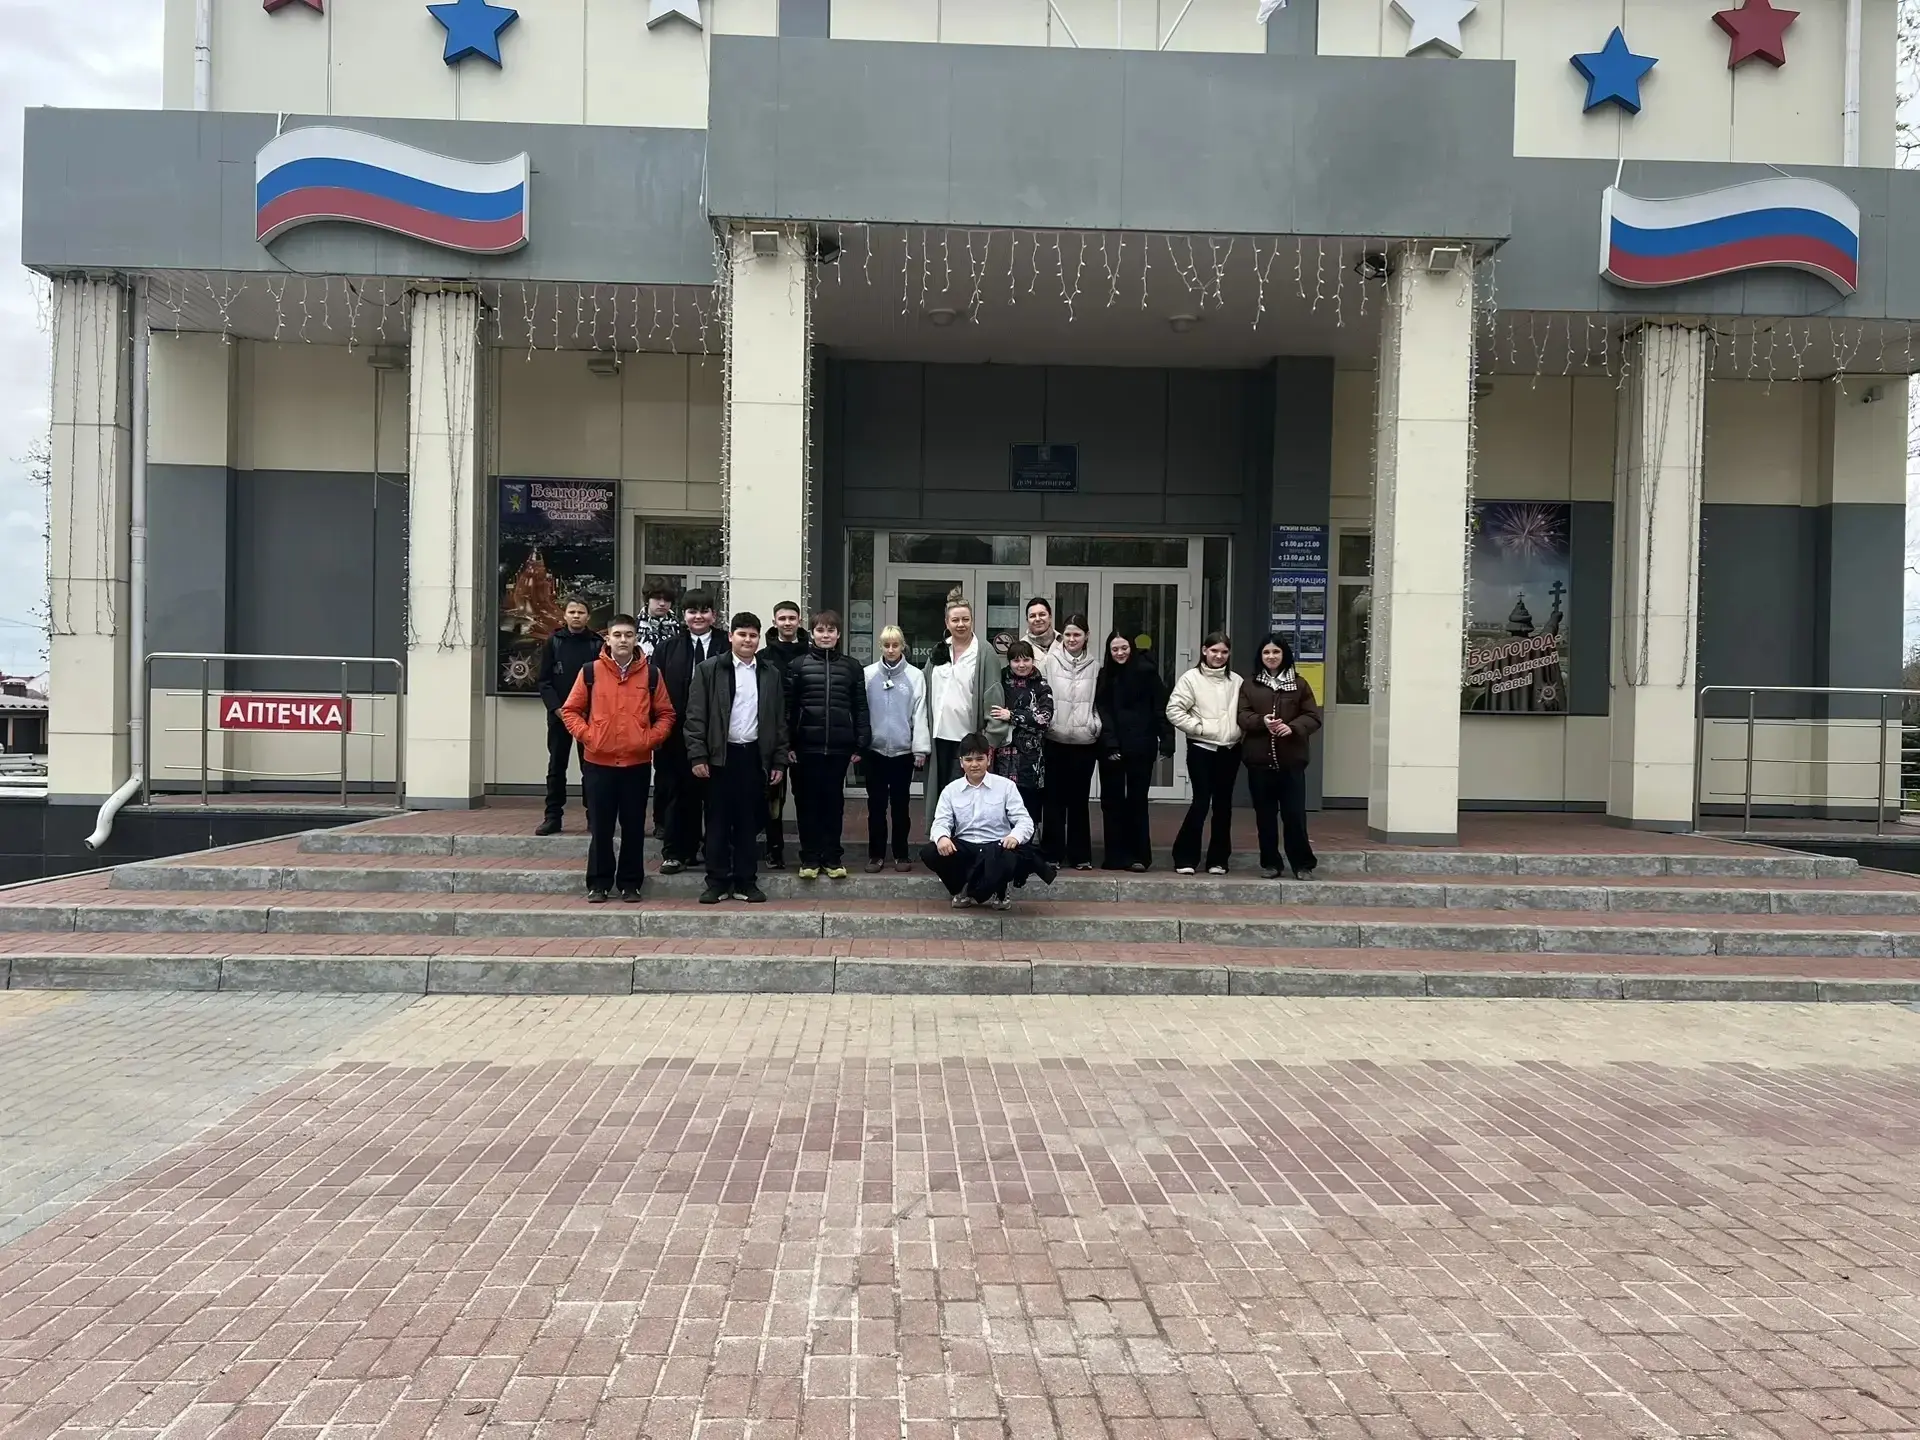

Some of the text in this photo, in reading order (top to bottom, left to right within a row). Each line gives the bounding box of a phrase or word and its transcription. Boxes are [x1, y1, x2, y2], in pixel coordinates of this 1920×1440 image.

[530, 484, 613, 502] Белгород-
[531, 500, 608, 511] город Первого
[1271, 577, 1327, 585] ИНФОРМАЦИЯ
[912, 647, 933, 658] ВХО
[1467, 633, 1562, 668] Белгород-
[1467, 651, 1560, 685] город воинской
[1492, 672, 1533, 694] славы!
[225, 701, 343, 726] АПТЕЧКА
